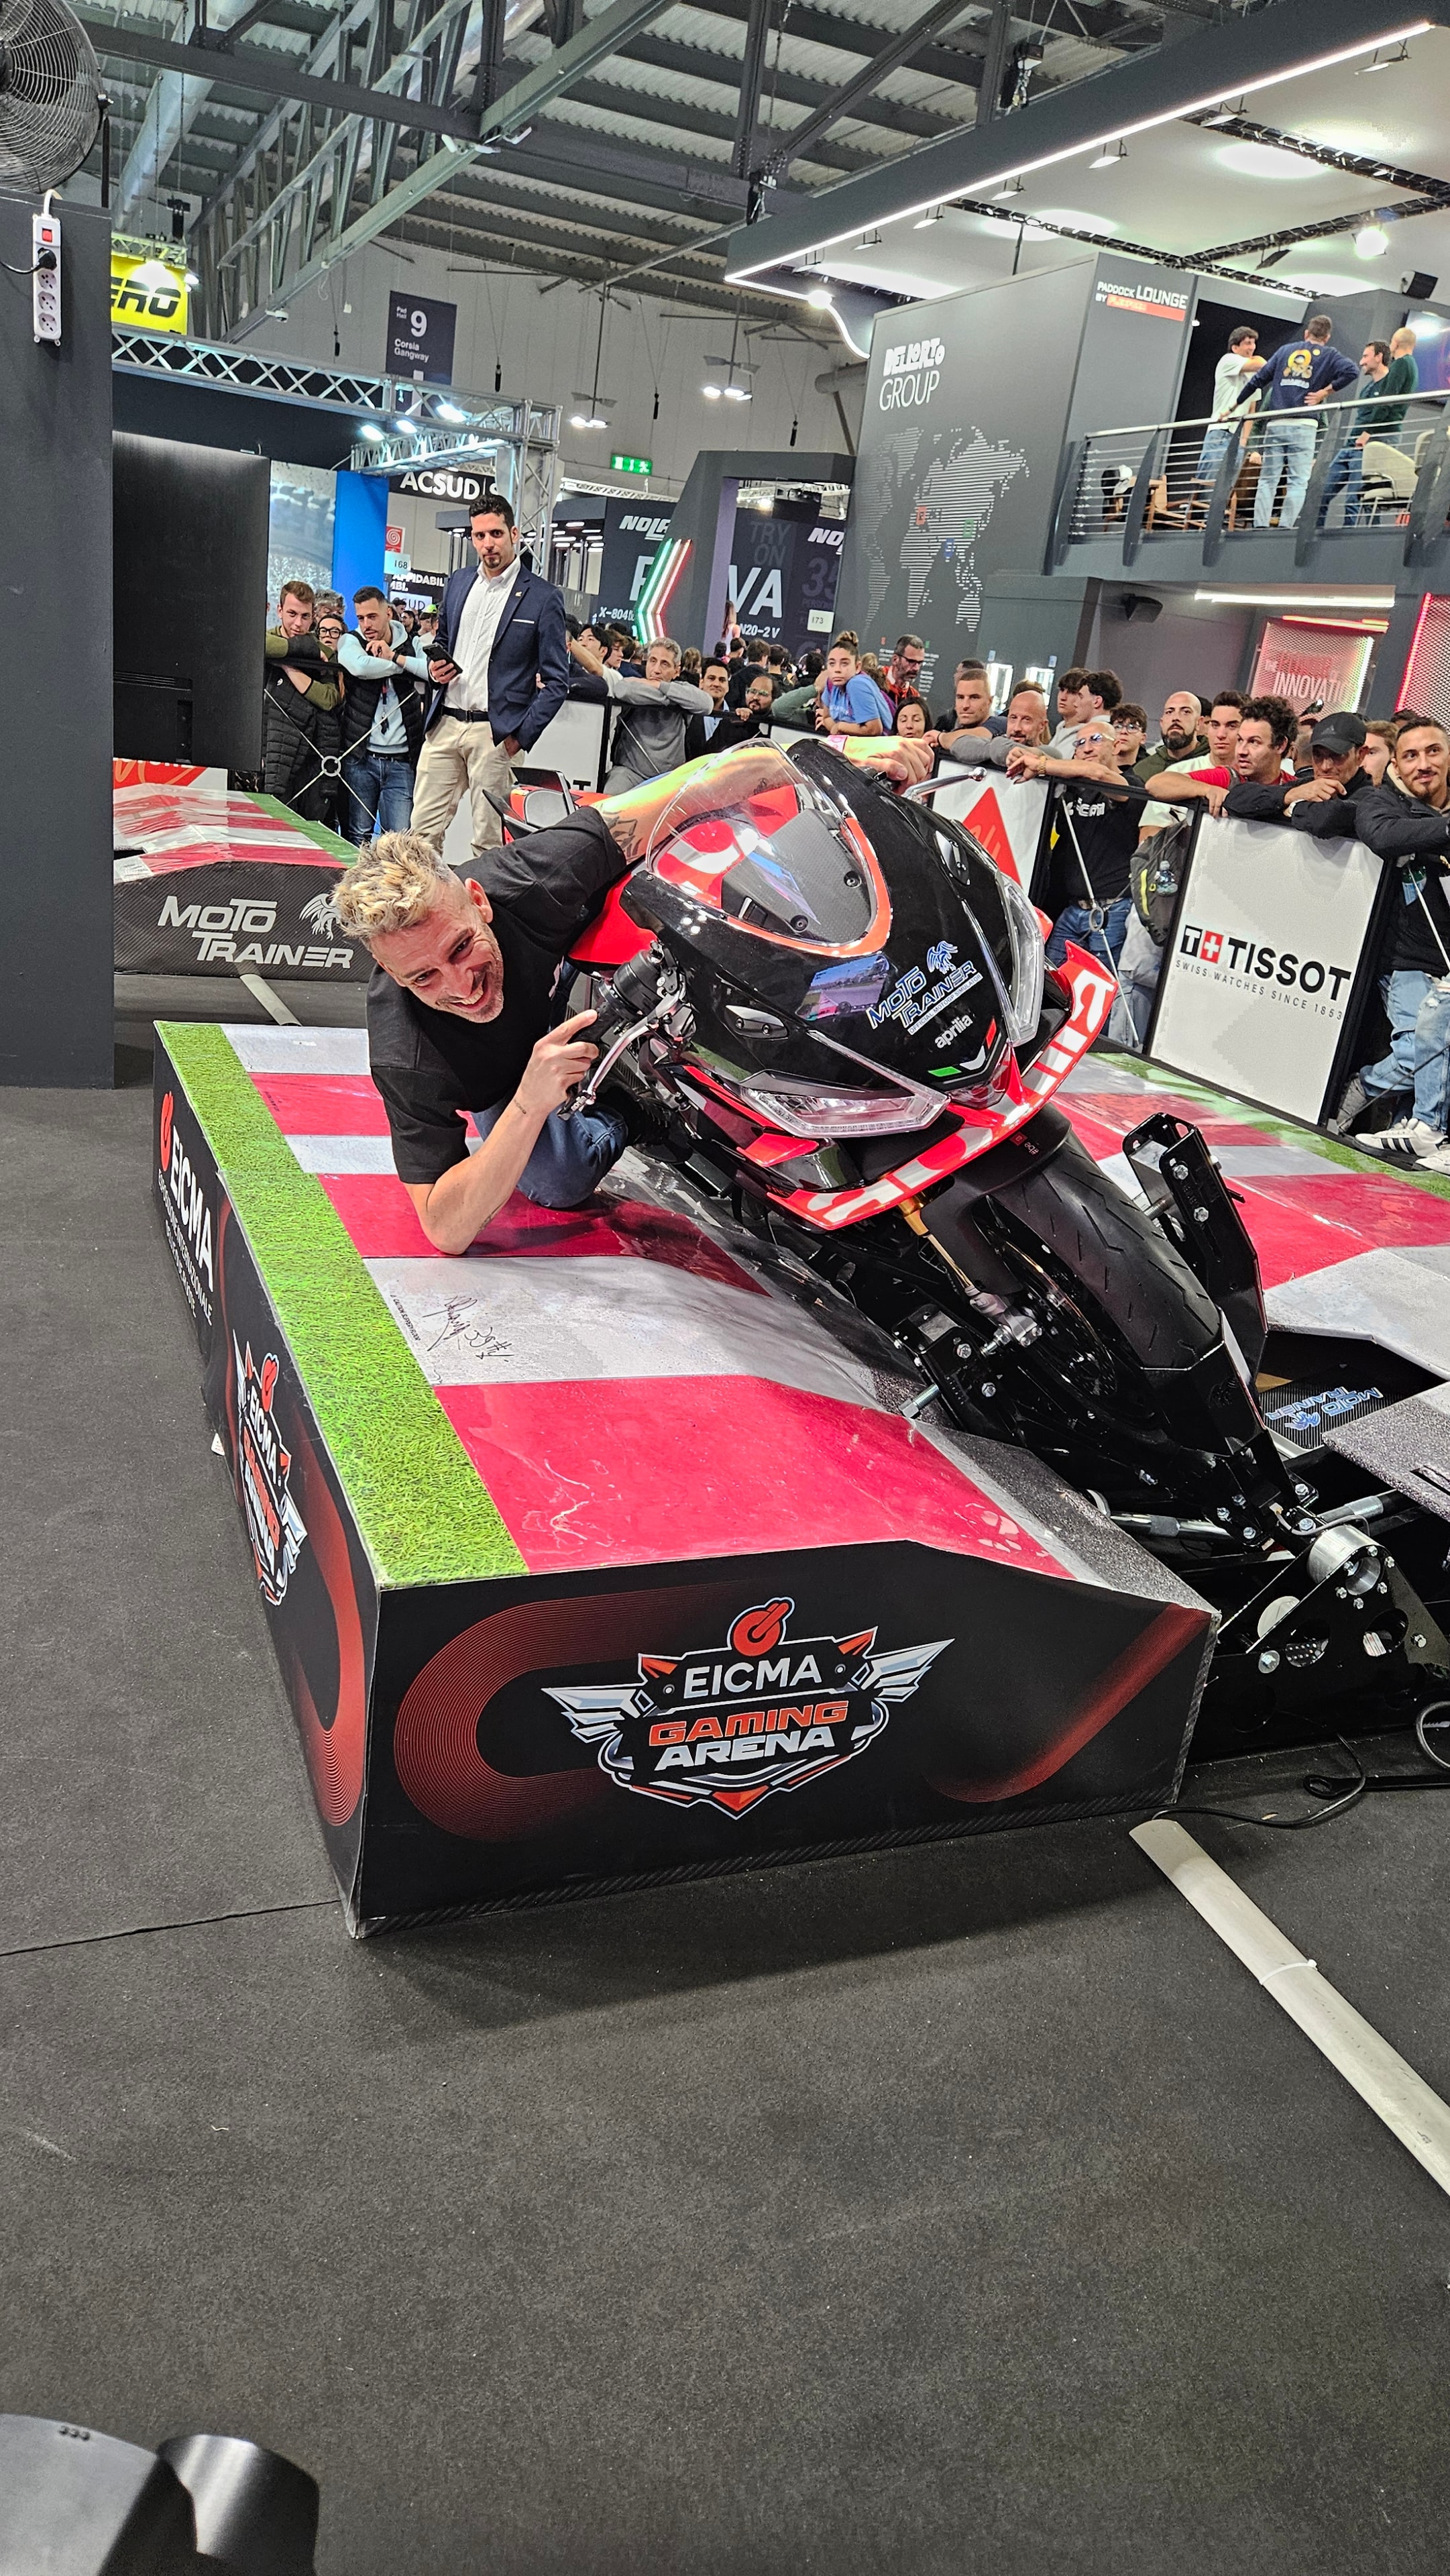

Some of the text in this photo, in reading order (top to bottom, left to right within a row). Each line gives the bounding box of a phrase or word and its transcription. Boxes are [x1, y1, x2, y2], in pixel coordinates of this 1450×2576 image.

[1095, 292, 1107, 303] BY
[1097, 281, 1136, 299] PADDOCK
[1135, 285, 1189, 310] LOUNGE
[410, 310, 427, 337] 9
[394, 338, 420, 351] Corsia
[394, 347, 429, 363] Gangway
[879, 370, 940, 411] GROUP
[400, 471, 480, 500] ACSUD
[748, 521, 792, 545] TRY
[752, 543, 787, 567] ON
[191, 930, 354, 969] TRAINER
[1227, 936, 1352, 1002] TISSOT
[866, 965, 928, 1030] MOTO
[891, 960, 977, 1029] TRAINER
[909, 1012, 934, 1034] OFFICIAL
[954, 973, 983, 998] SIMULATOR
[1176, 959, 1343, 1020] SWISS WATCHES SINCE 1853
[935, 1014, 974, 1049] aprilia
[170, 1125, 213, 1293] EICMA
[1265, 1386, 1357, 1421] TRAINER
[249, 1384, 277, 1485] EICMA
[683, 1655, 822, 1699] EICMA
[649, 1700, 848, 1747] GAMING
[655, 1726, 835, 1772] ARENA
